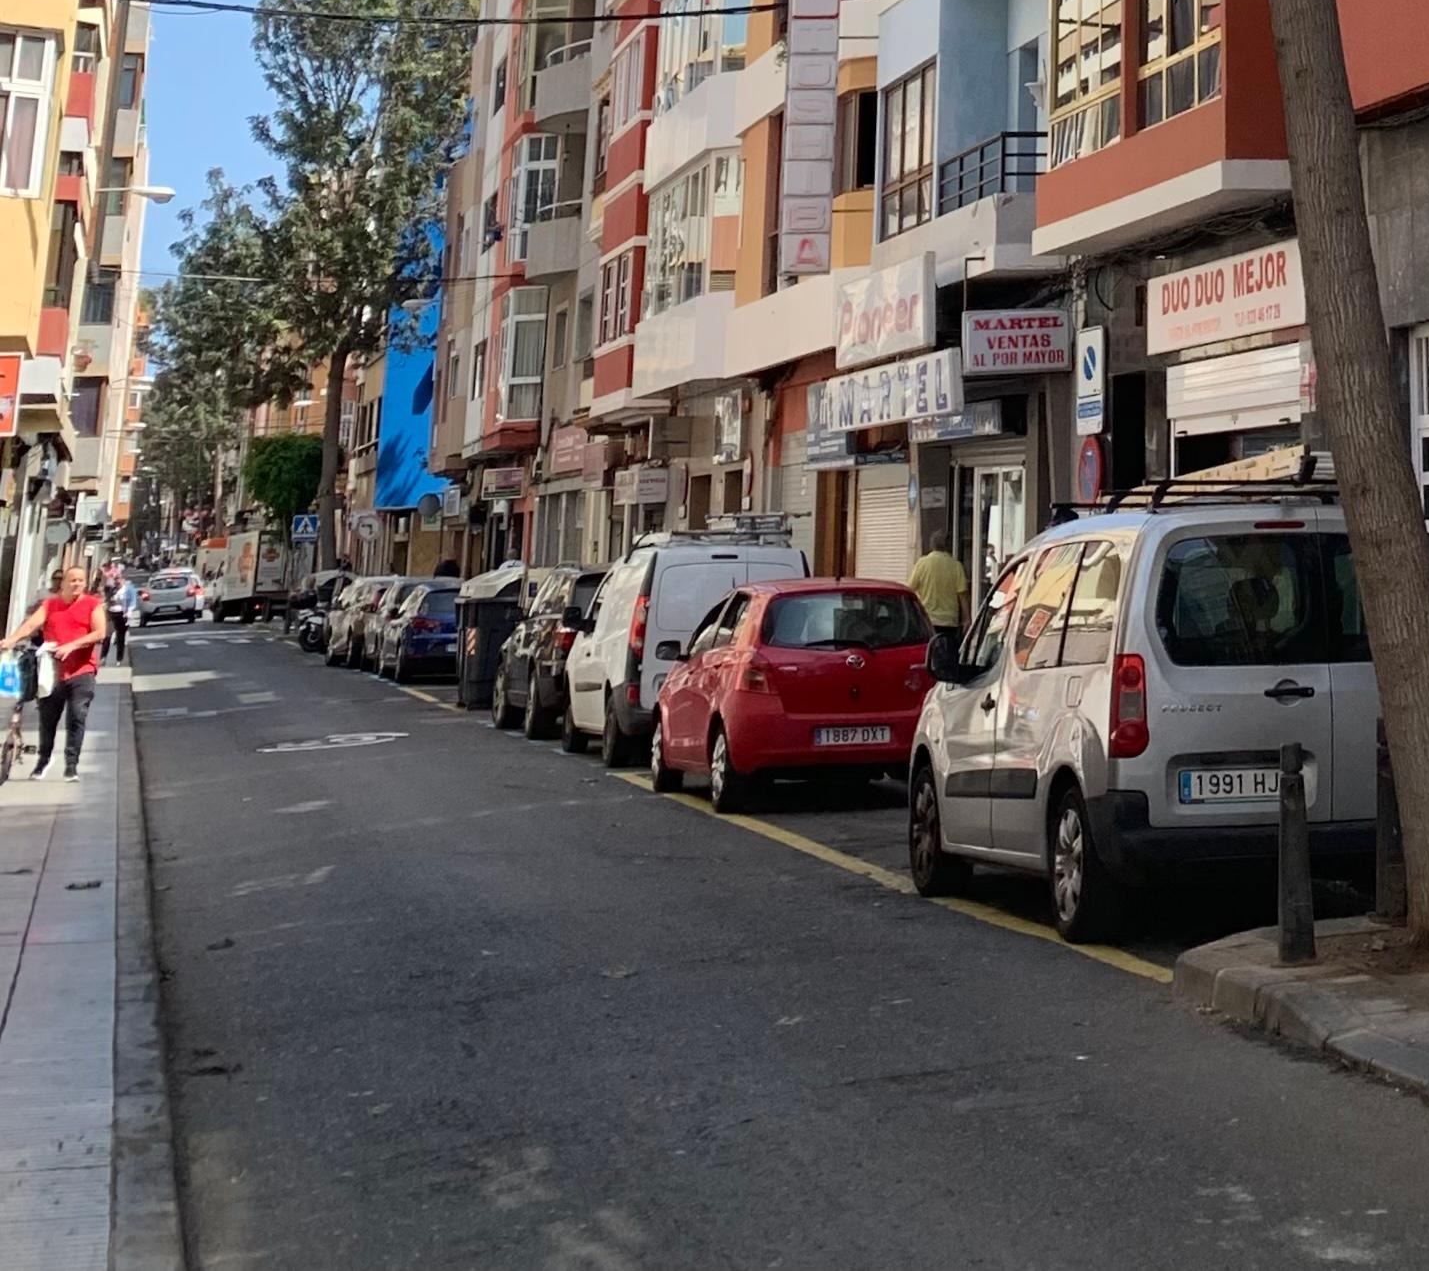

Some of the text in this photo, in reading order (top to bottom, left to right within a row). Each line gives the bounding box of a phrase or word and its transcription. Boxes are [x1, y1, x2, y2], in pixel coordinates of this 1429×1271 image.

[1161, 250, 1287, 316] DUO DUO MEJOR
[841, 293, 920, 346] Pioneer
[973, 316, 1064, 331] MARTEL
[986, 333, 1051, 350] VENTAS
[973, 349, 1065, 367] AL POR MAYOR
[838, 357, 949, 428] MARTEL
[826, 727, 887, 743] 1887 DXT
[1197, 771, 1280, 796] 1991 HJ
